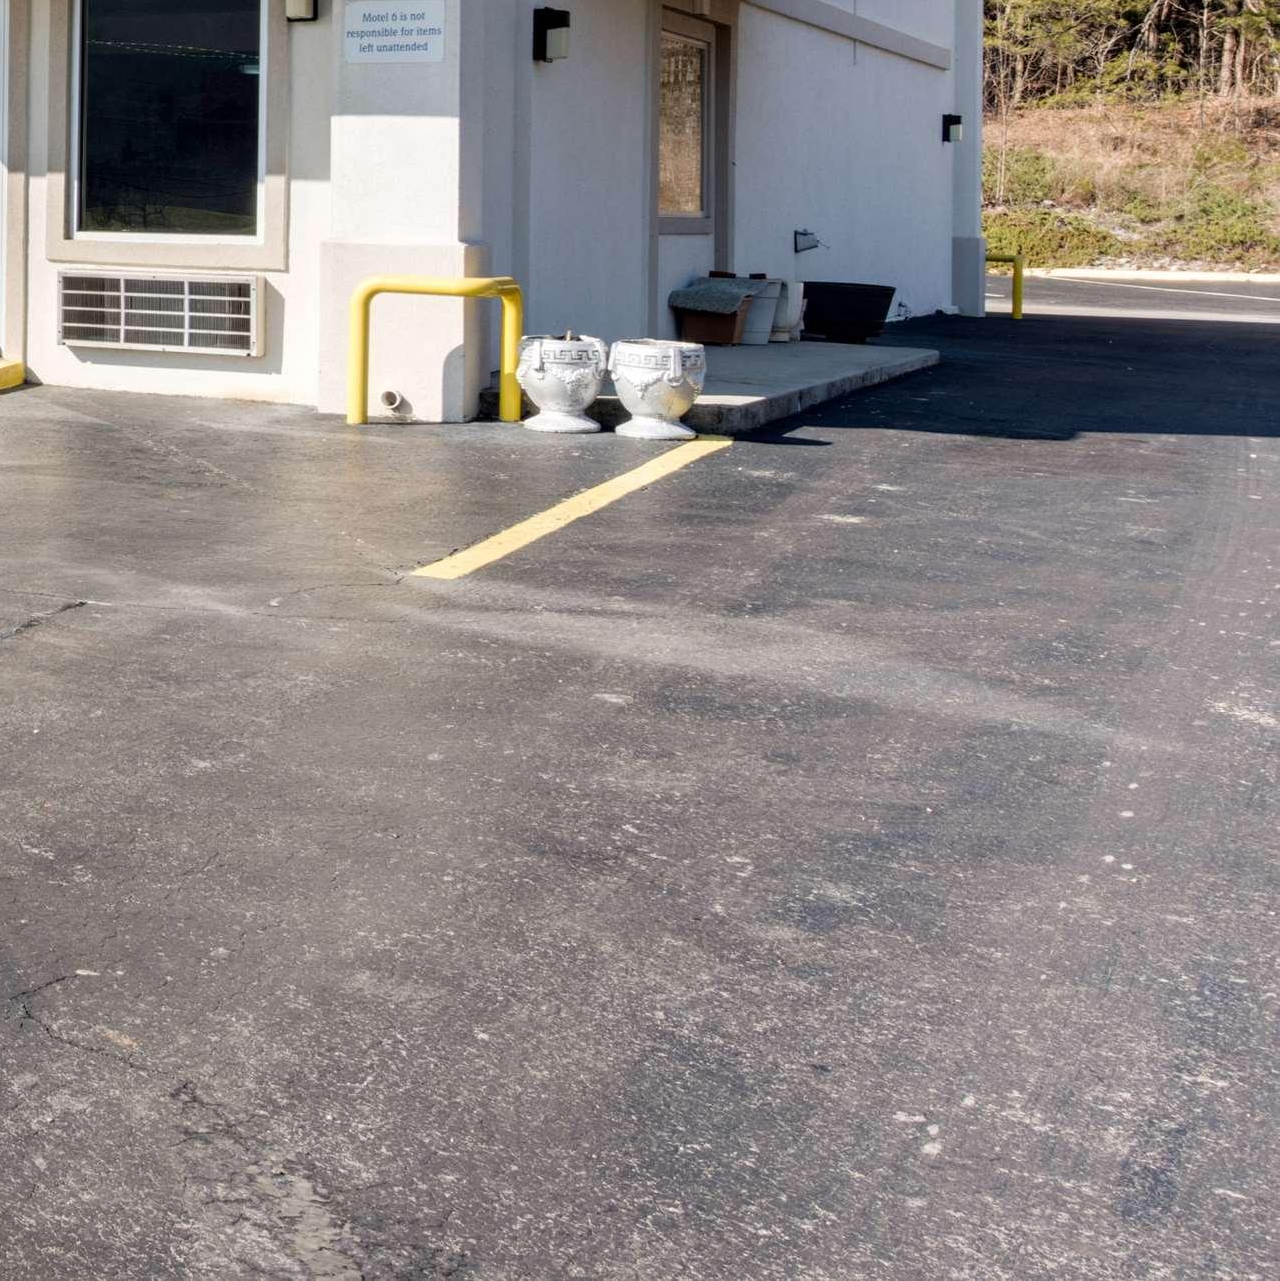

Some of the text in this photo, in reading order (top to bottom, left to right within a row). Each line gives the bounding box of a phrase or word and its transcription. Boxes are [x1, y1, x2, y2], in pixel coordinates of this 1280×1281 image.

[362, 12, 426, 23] Motel 6 is not
[346, 27, 442, 39] responsible for items
[359, 42, 429, 53] left unattended
